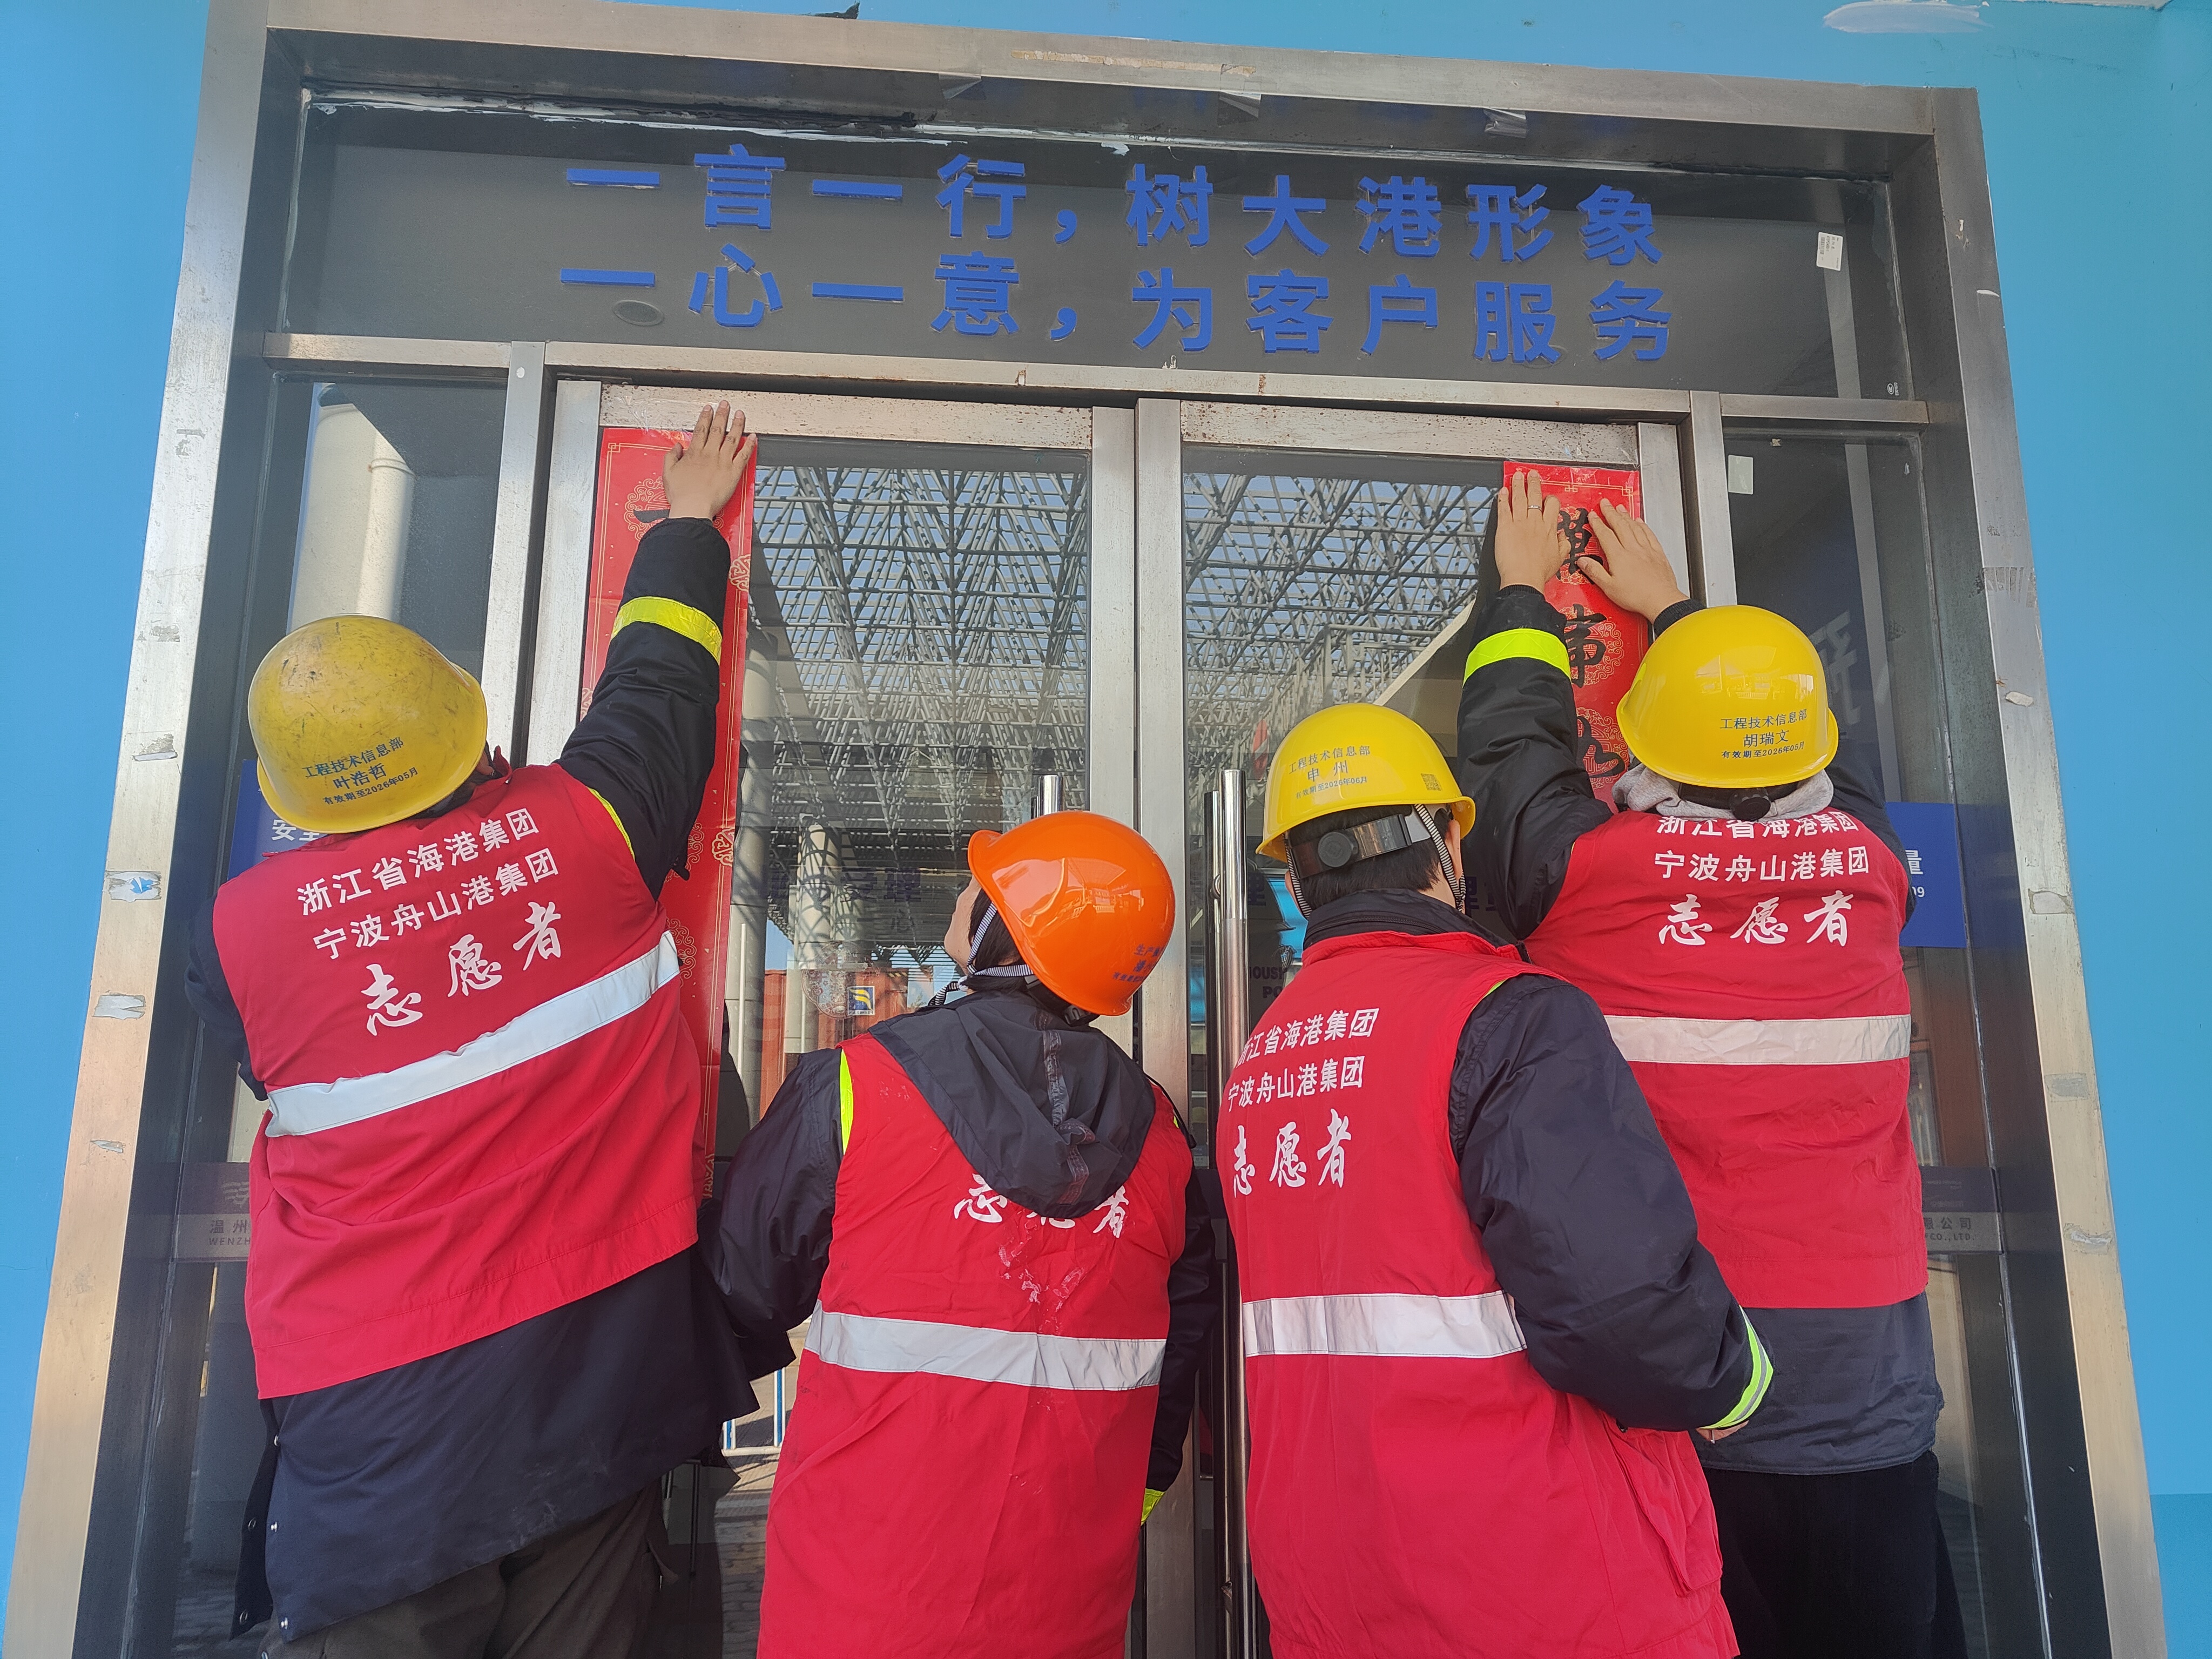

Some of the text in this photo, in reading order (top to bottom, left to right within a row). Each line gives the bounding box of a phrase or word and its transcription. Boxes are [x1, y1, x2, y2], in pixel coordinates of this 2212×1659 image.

[1720, 709, 1808, 730] 工程技术信息部
[1743, 729, 1790, 748] 胡瑞文
[302, 737, 404, 779] 工程技术信息部
[1289, 745, 1371, 774] 工程技术信息部
[1721, 741, 1805, 759] 有效期至2026年05月
[322, 767, 419, 805] 有效期至2026年05月
[333, 763, 387, 790] 叶浩哲
[1296, 777, 1367, 799] 有效期至2026年06月
[298, 808, 539, 916] 浙江省海港集团
[1655, 846, 1870, 883] 宁波舟山港集团
[313, 848, 559, 960] 宁波舟山港集团
[1658, 890, 1855, 947] 志愿者
[361, 901, 561, 1036] 志愿者
[1228, 1055, 1365, 1112] 宁波舟山港集团
[1233, 1108, 1351, 1198] 志愿者
[954, 1173, 1129, 1238] 志者
[210, 1219, 248, 1233] 温州
